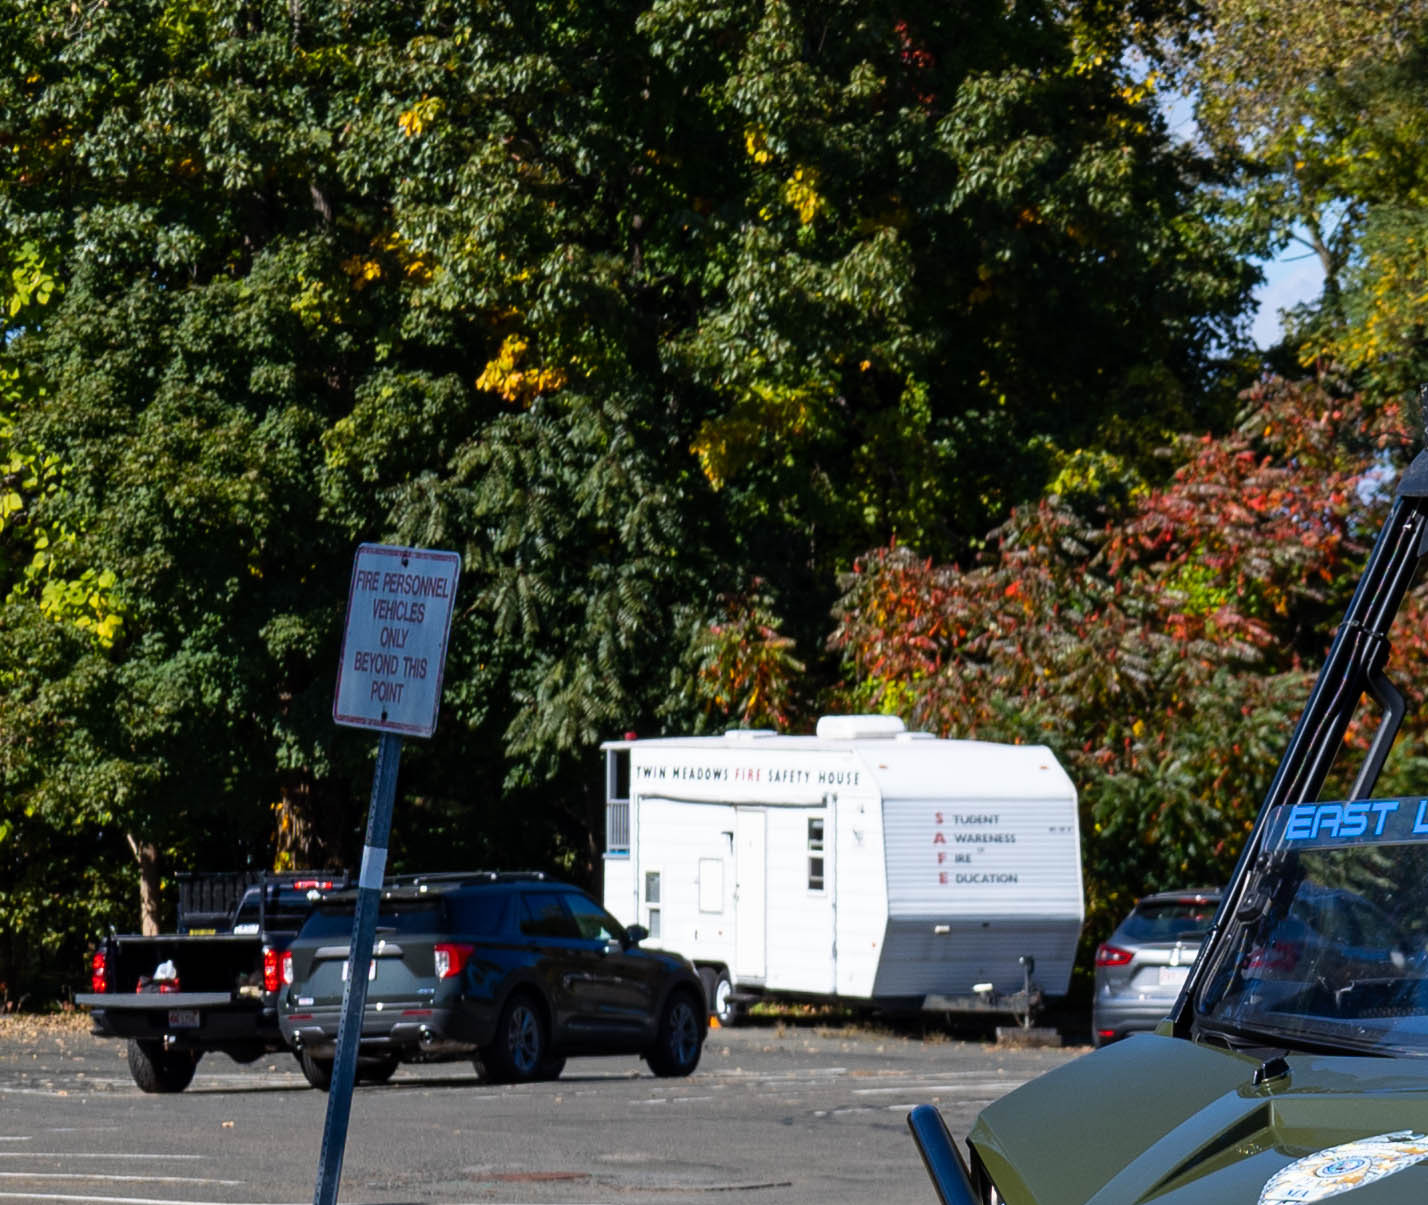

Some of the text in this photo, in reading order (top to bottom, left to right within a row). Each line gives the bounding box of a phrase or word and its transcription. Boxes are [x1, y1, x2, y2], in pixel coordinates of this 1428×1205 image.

[356, 570, 449, 598] FIRE PERSONNEL
[372, 598, 425, 623] VEHICLES
[380, 627, 409, 649] ONLY
[354, 651, 428, 679] BEYOND THIS
[370, 681, 404, 702] POINT
[636, 766, 860, 785] TWIN MEADOWS FIRE SAFETY HOUSE
[1286, 799, 1398, 840] EAST
[955, 833, 1016, 843] WARENESS
[956, 873, 1018, 883] DUCATION
